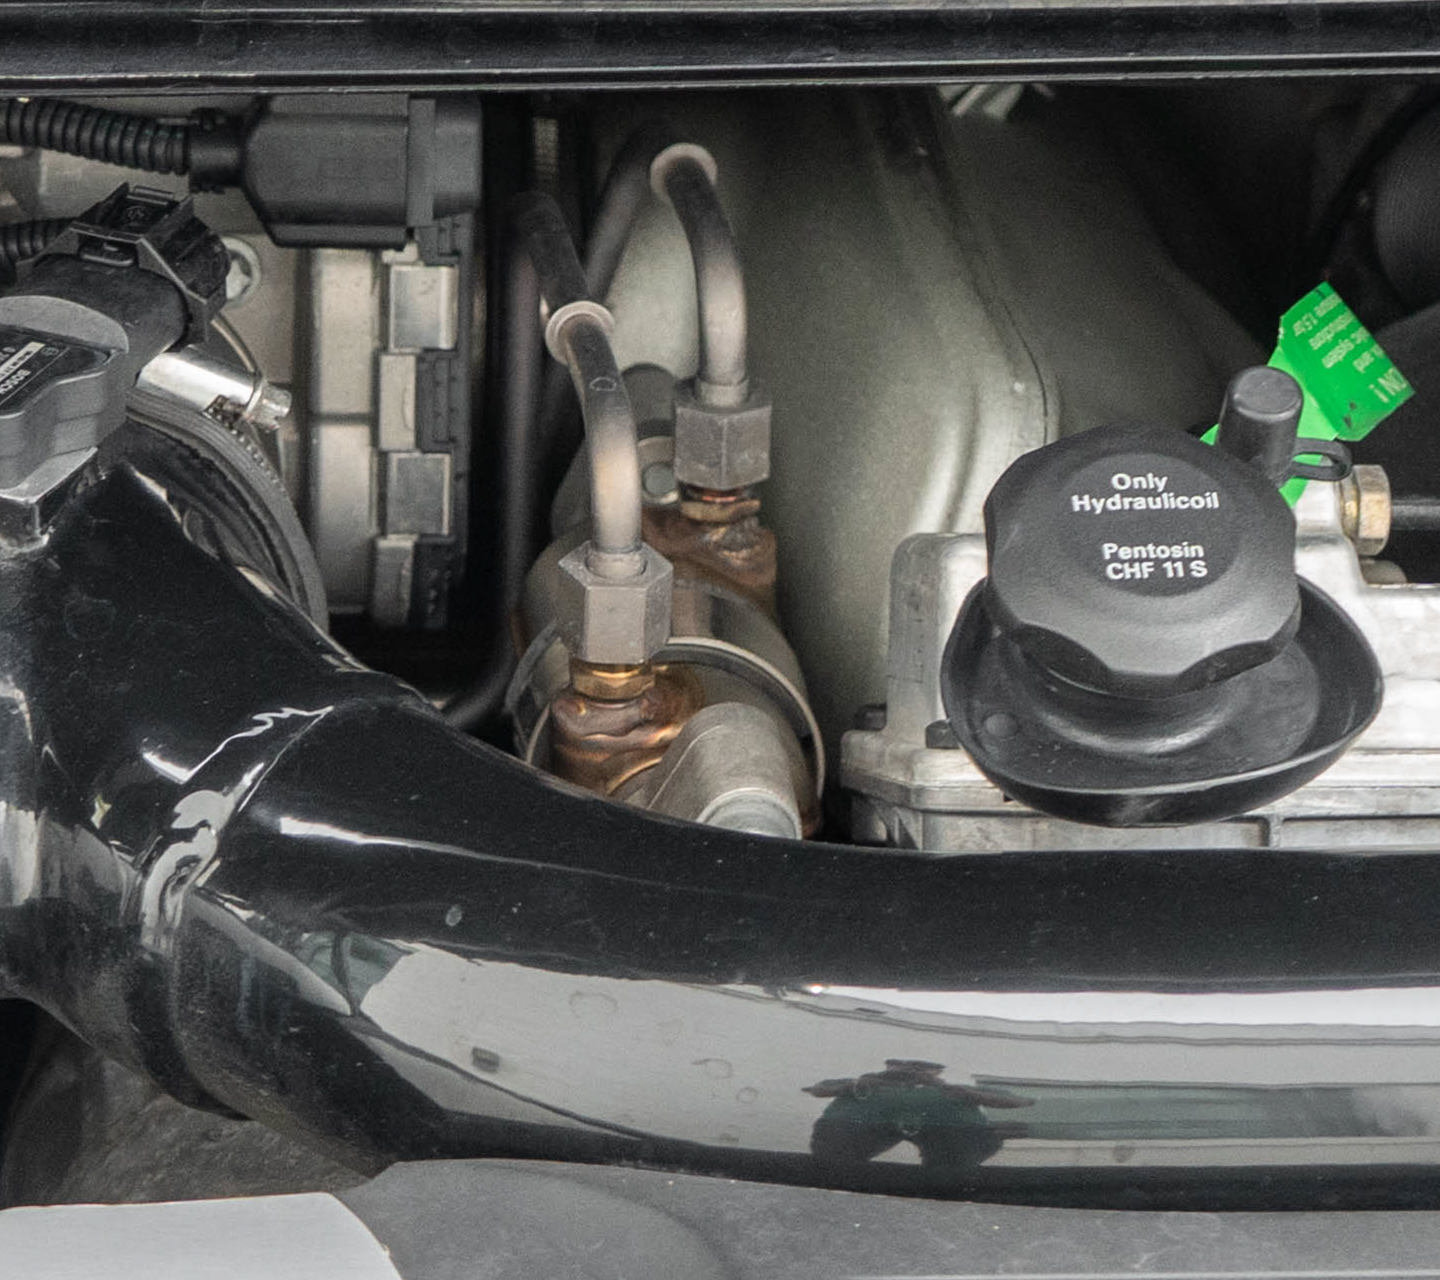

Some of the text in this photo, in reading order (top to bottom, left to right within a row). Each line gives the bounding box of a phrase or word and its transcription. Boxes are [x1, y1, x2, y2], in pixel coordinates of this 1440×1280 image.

[1111, 472, 1167, 492] Only
[1071, 491, 1220, 514] Hydraulicoil
[1102, 542, 1204, 560] Pentosin
[1106, 560, 1208, 580] CHF 11 S
